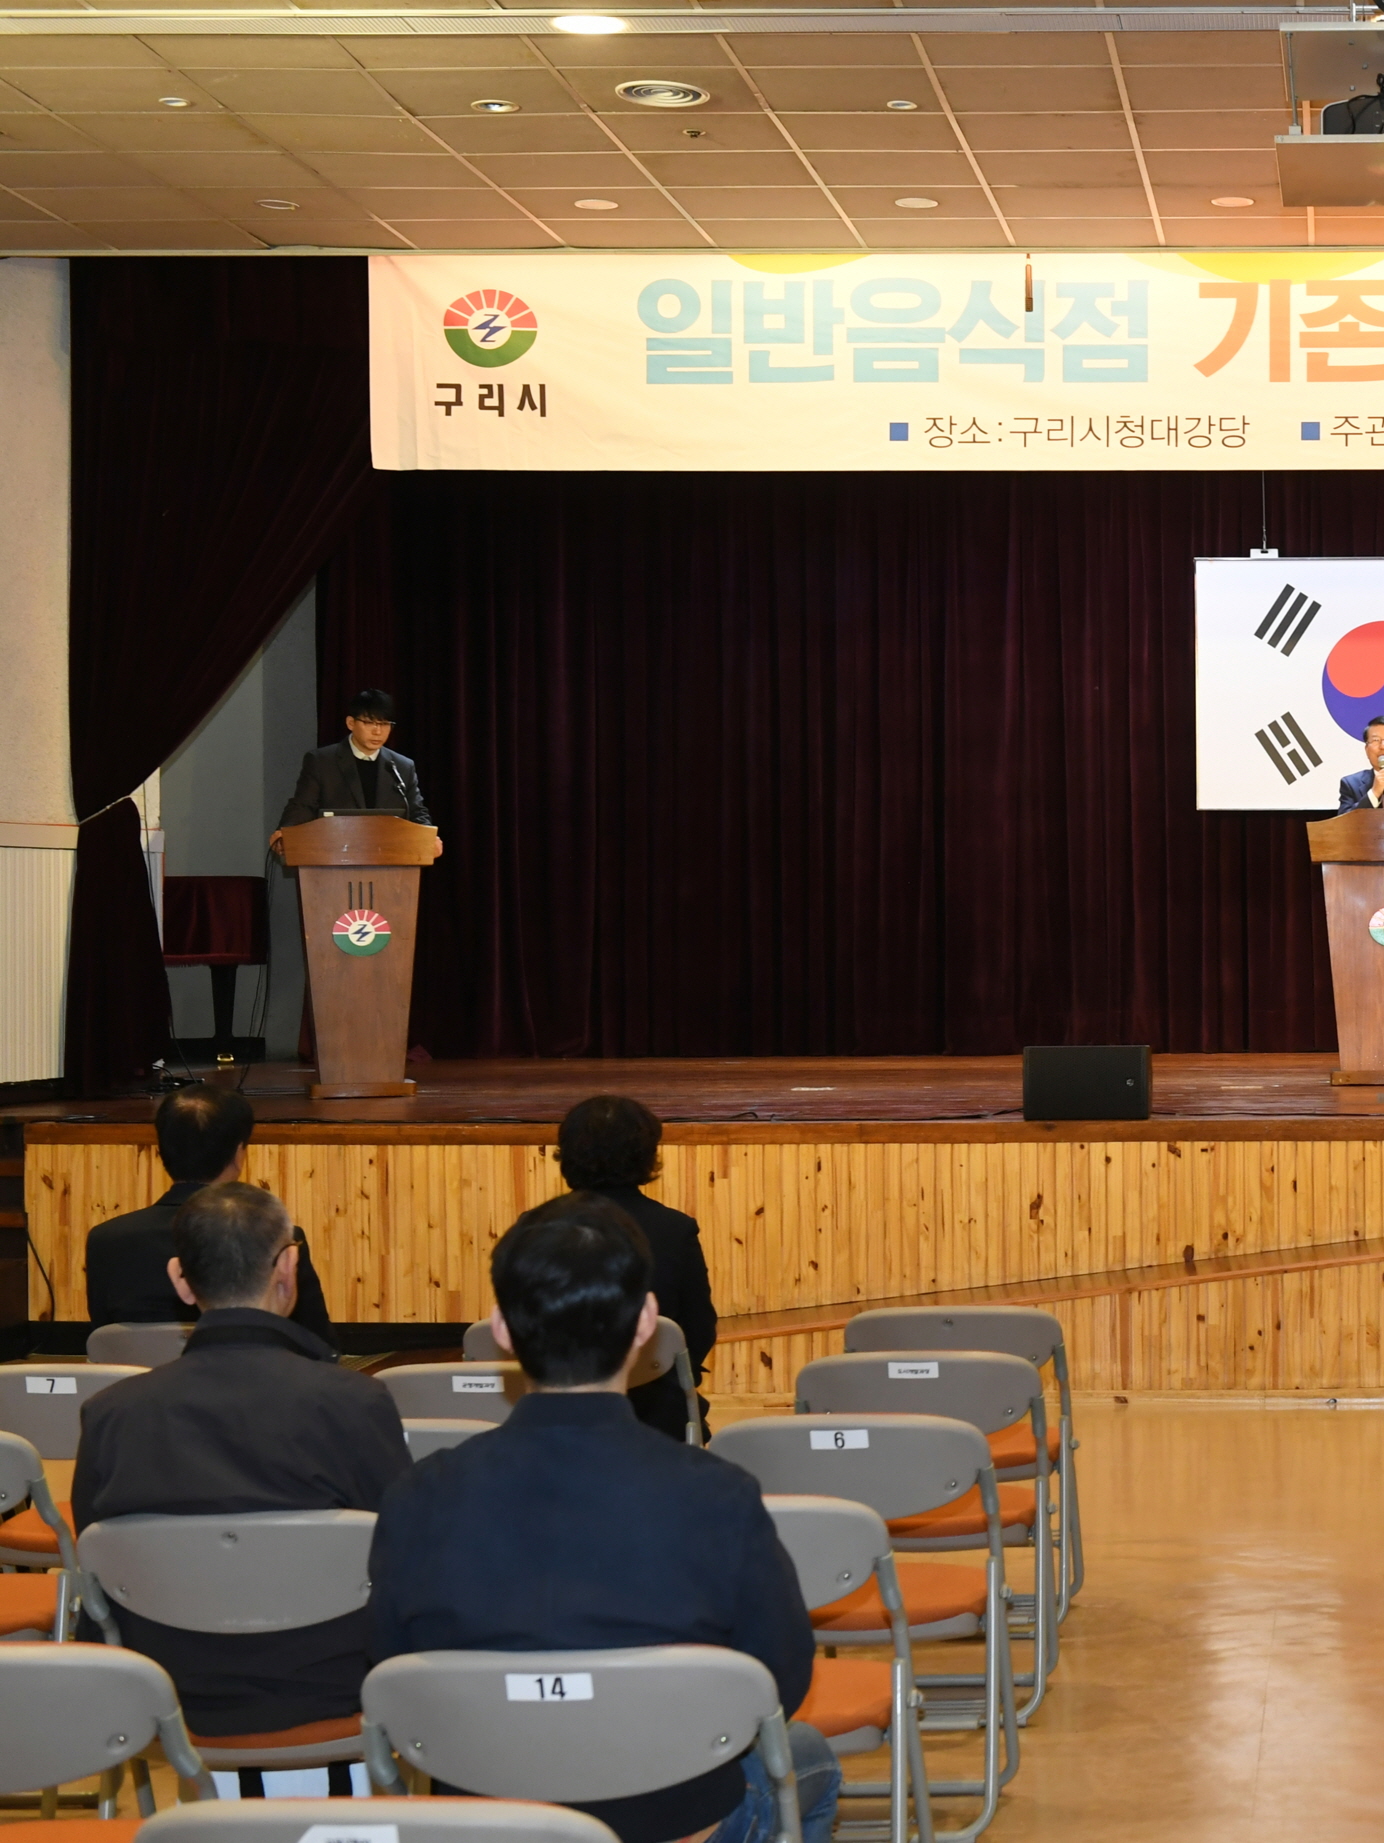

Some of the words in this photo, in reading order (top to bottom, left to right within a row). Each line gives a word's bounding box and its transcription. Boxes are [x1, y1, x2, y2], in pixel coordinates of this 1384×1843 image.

[636, 278, 1149, 385] 일반음식점
[434, 383, 548, 418] 구리시
[45, 1378, 56, 1393] 7
[833, 1431, 846, 1450] 6
[534, 1676, 567, 1700] 14
